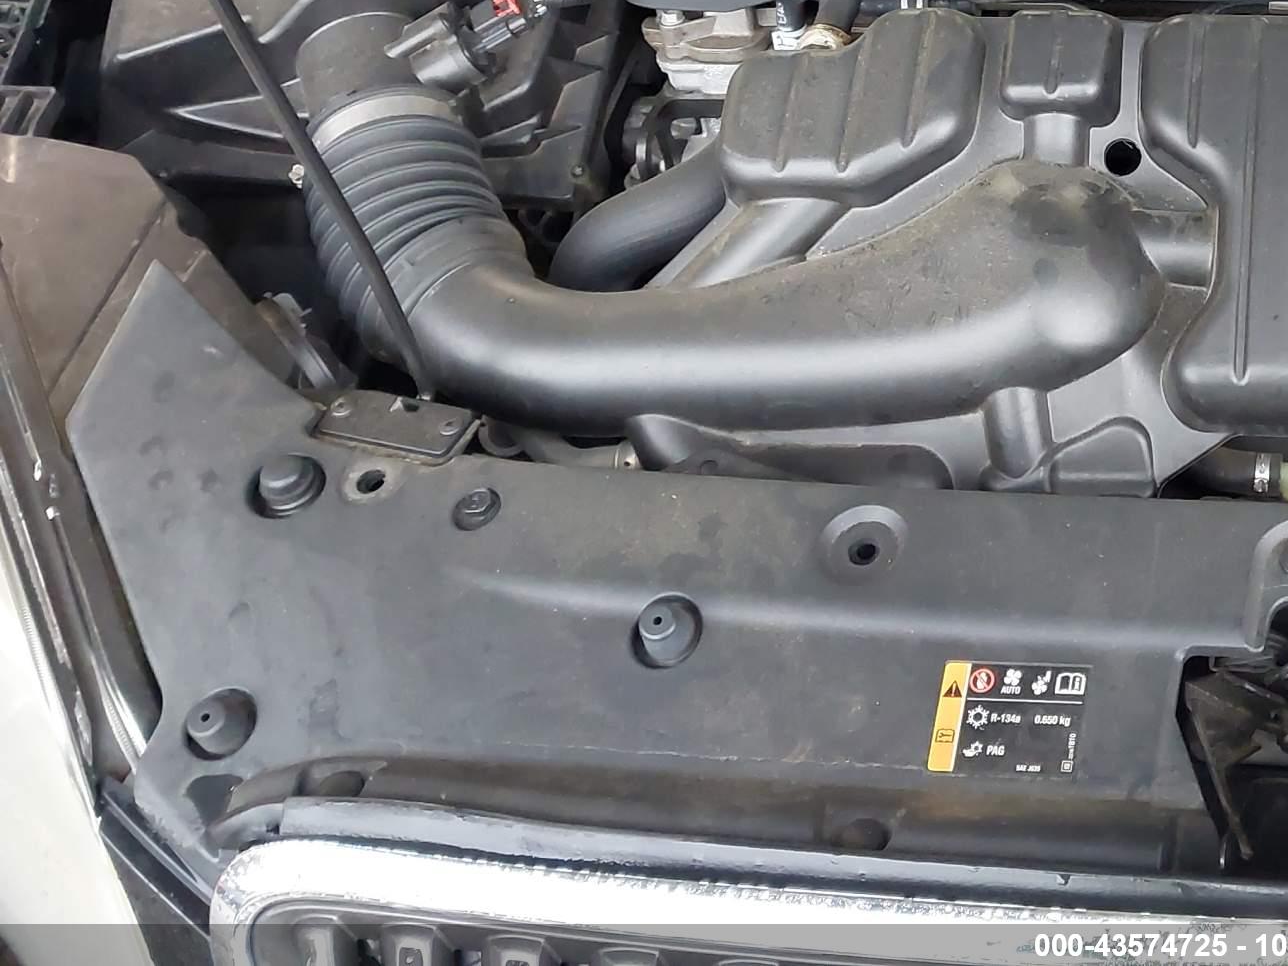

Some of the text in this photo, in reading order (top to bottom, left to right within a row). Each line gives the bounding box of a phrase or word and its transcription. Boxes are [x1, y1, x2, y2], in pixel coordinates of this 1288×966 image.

[1000, 686, 1021, 695] AUTO
[990, 714, 1021, 724] R-134a
[1059, 716, 1071, 727] kg
[986, 745, 1005, 756] PAG
